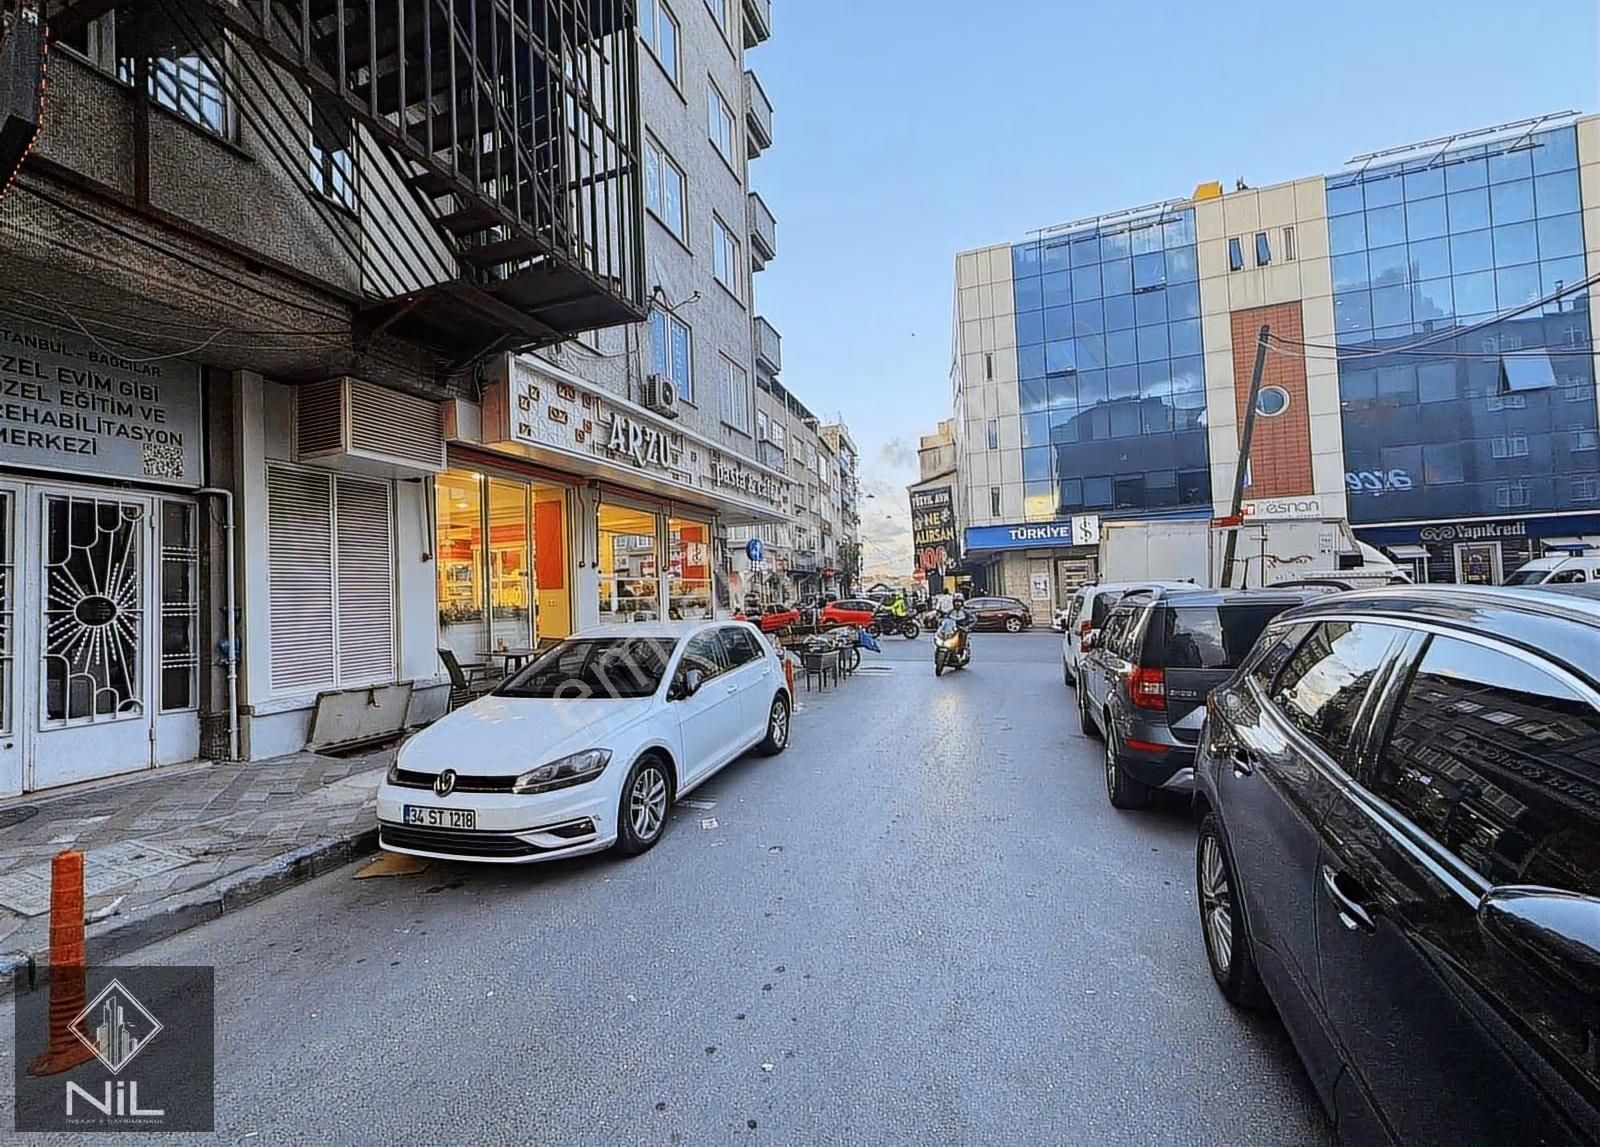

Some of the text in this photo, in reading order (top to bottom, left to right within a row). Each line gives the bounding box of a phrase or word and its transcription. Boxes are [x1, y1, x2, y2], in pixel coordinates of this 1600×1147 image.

[0, 329, 73, 356] TANBUL
[0, 354, 159, 402] ZEL EVİM GİBİ
[0, 379, 165, 424] ZEL EĞİTİM VE
[608, 413, 669, 467] ARZU
[924, 511, 941, 527] NE
[1009, 525, 1069, 541] TÜRKİYE
[410, 808, 474, 828] 34 ST 1218
